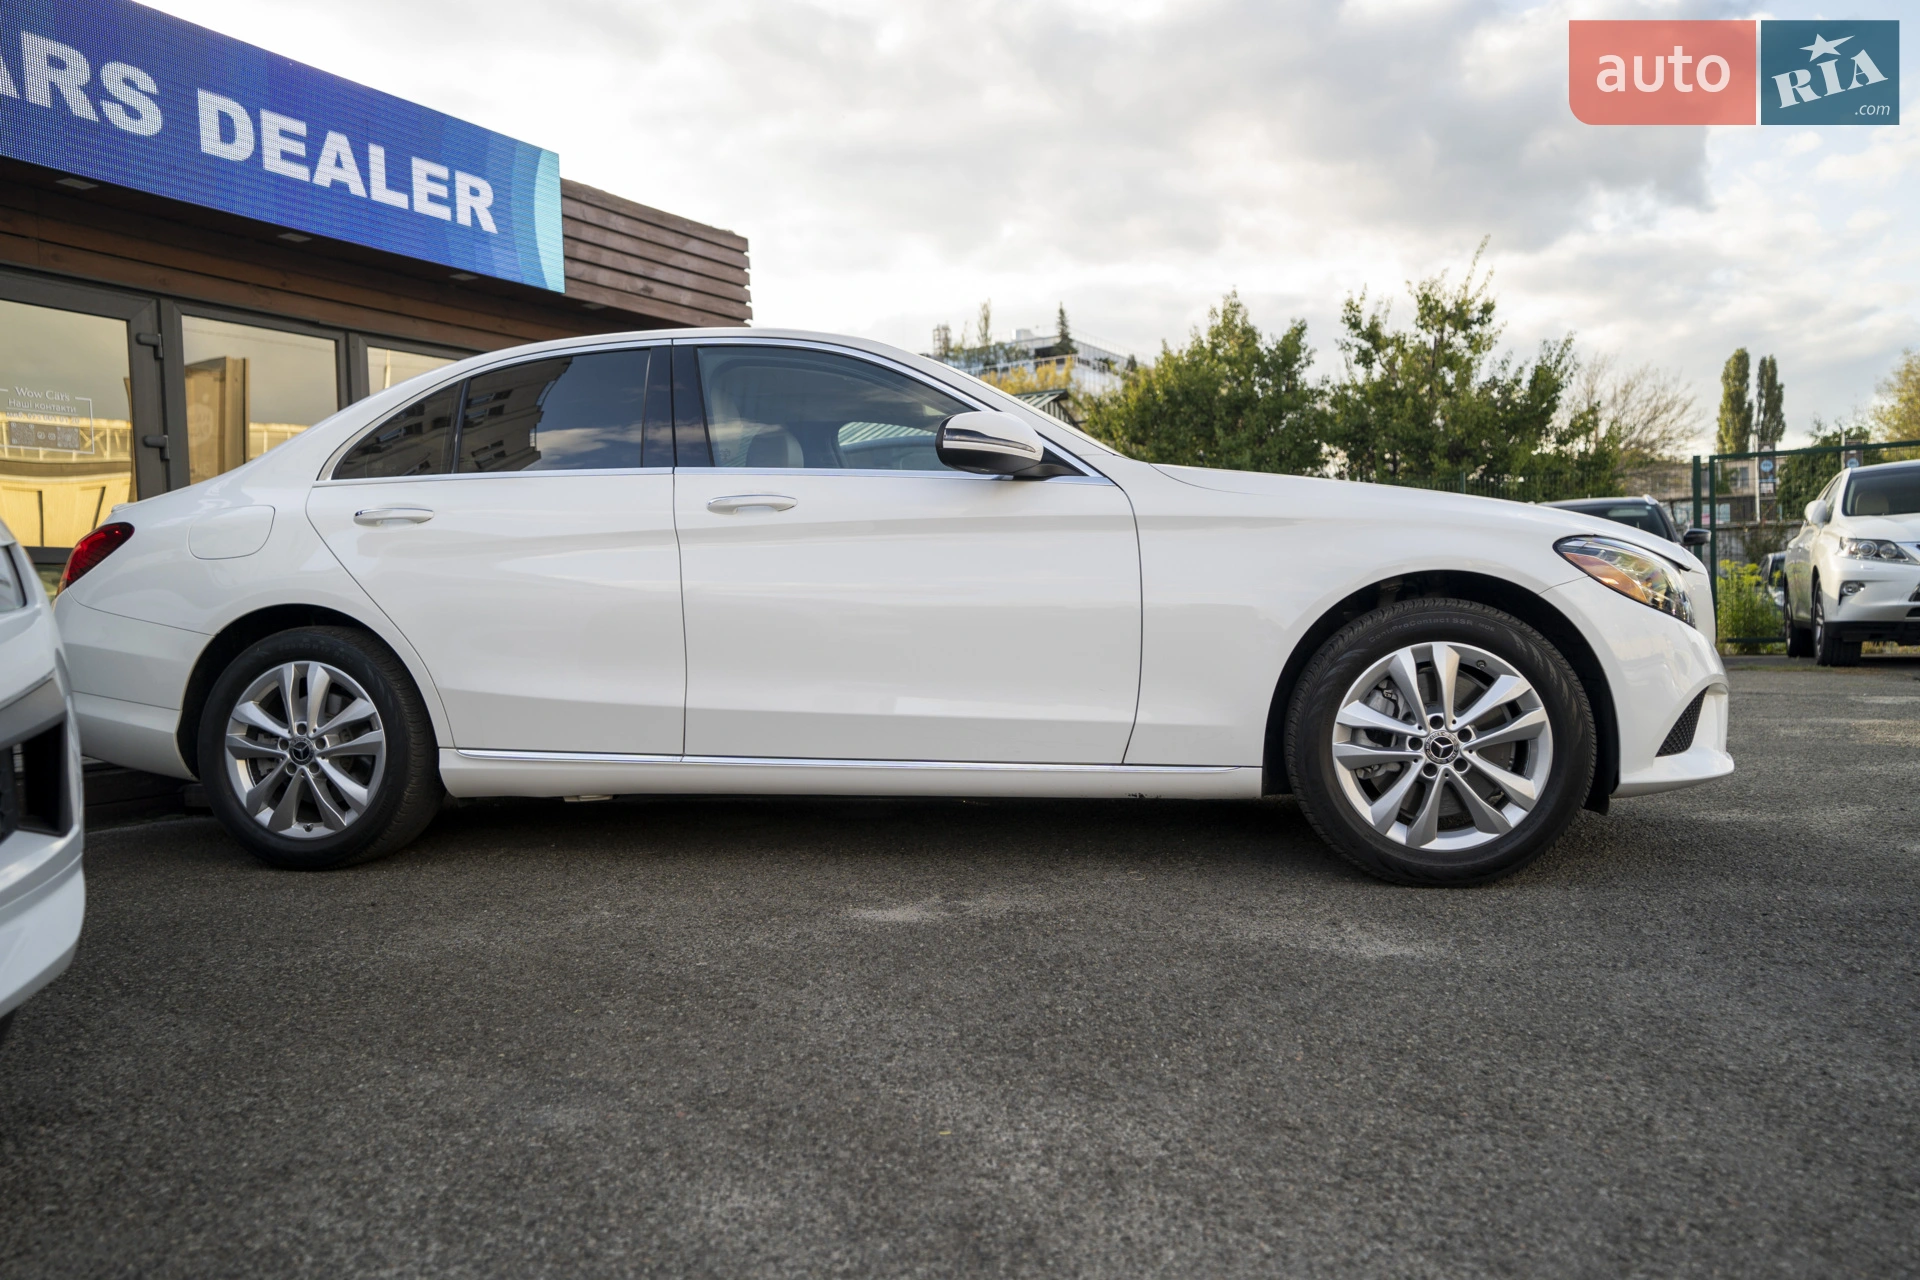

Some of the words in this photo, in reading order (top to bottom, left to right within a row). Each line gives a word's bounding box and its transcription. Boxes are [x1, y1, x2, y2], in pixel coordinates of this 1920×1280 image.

[197, 88, 498, 235] DEALER
[15, 387, 42, 398] Wow
[45, 391, 70, 401] Cars
[8, 399, 32, 408] Наші
[34, 402, 76, 413] контакти
[1368, 618, 1450, 643] ContiProContact
[1452, 618, 1474, 626] SSR
